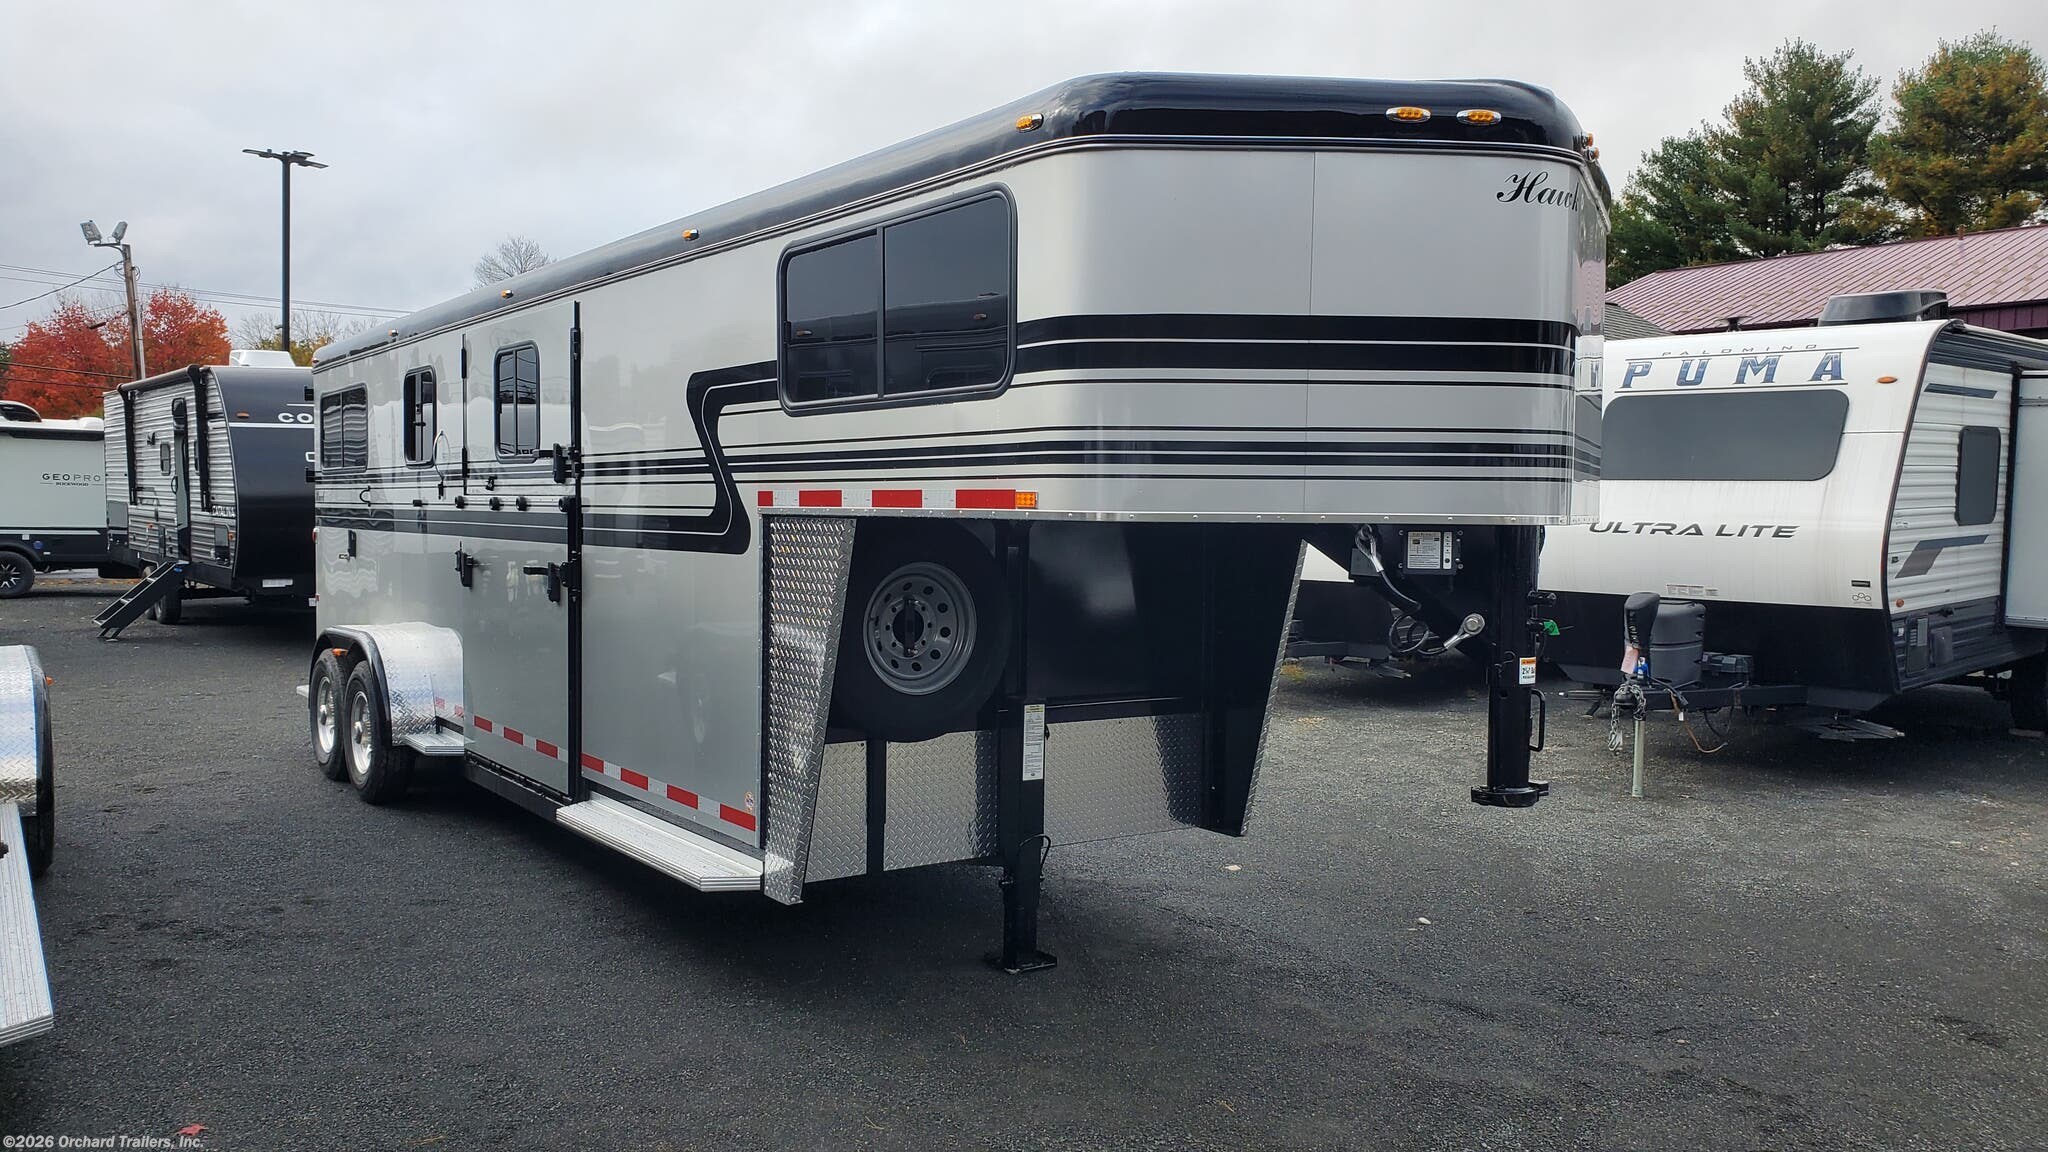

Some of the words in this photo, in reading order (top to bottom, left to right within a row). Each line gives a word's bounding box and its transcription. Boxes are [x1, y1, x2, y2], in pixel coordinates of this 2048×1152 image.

[1662, 344, 1817, 357] PALOMINO
[1620, 351, 1844, 389] PUMA
[42, 473, 101, 481] GEOPRO
[1589, 521, 1704, 536] ULTRA
[1715, 524, 1800, 538] LITE
